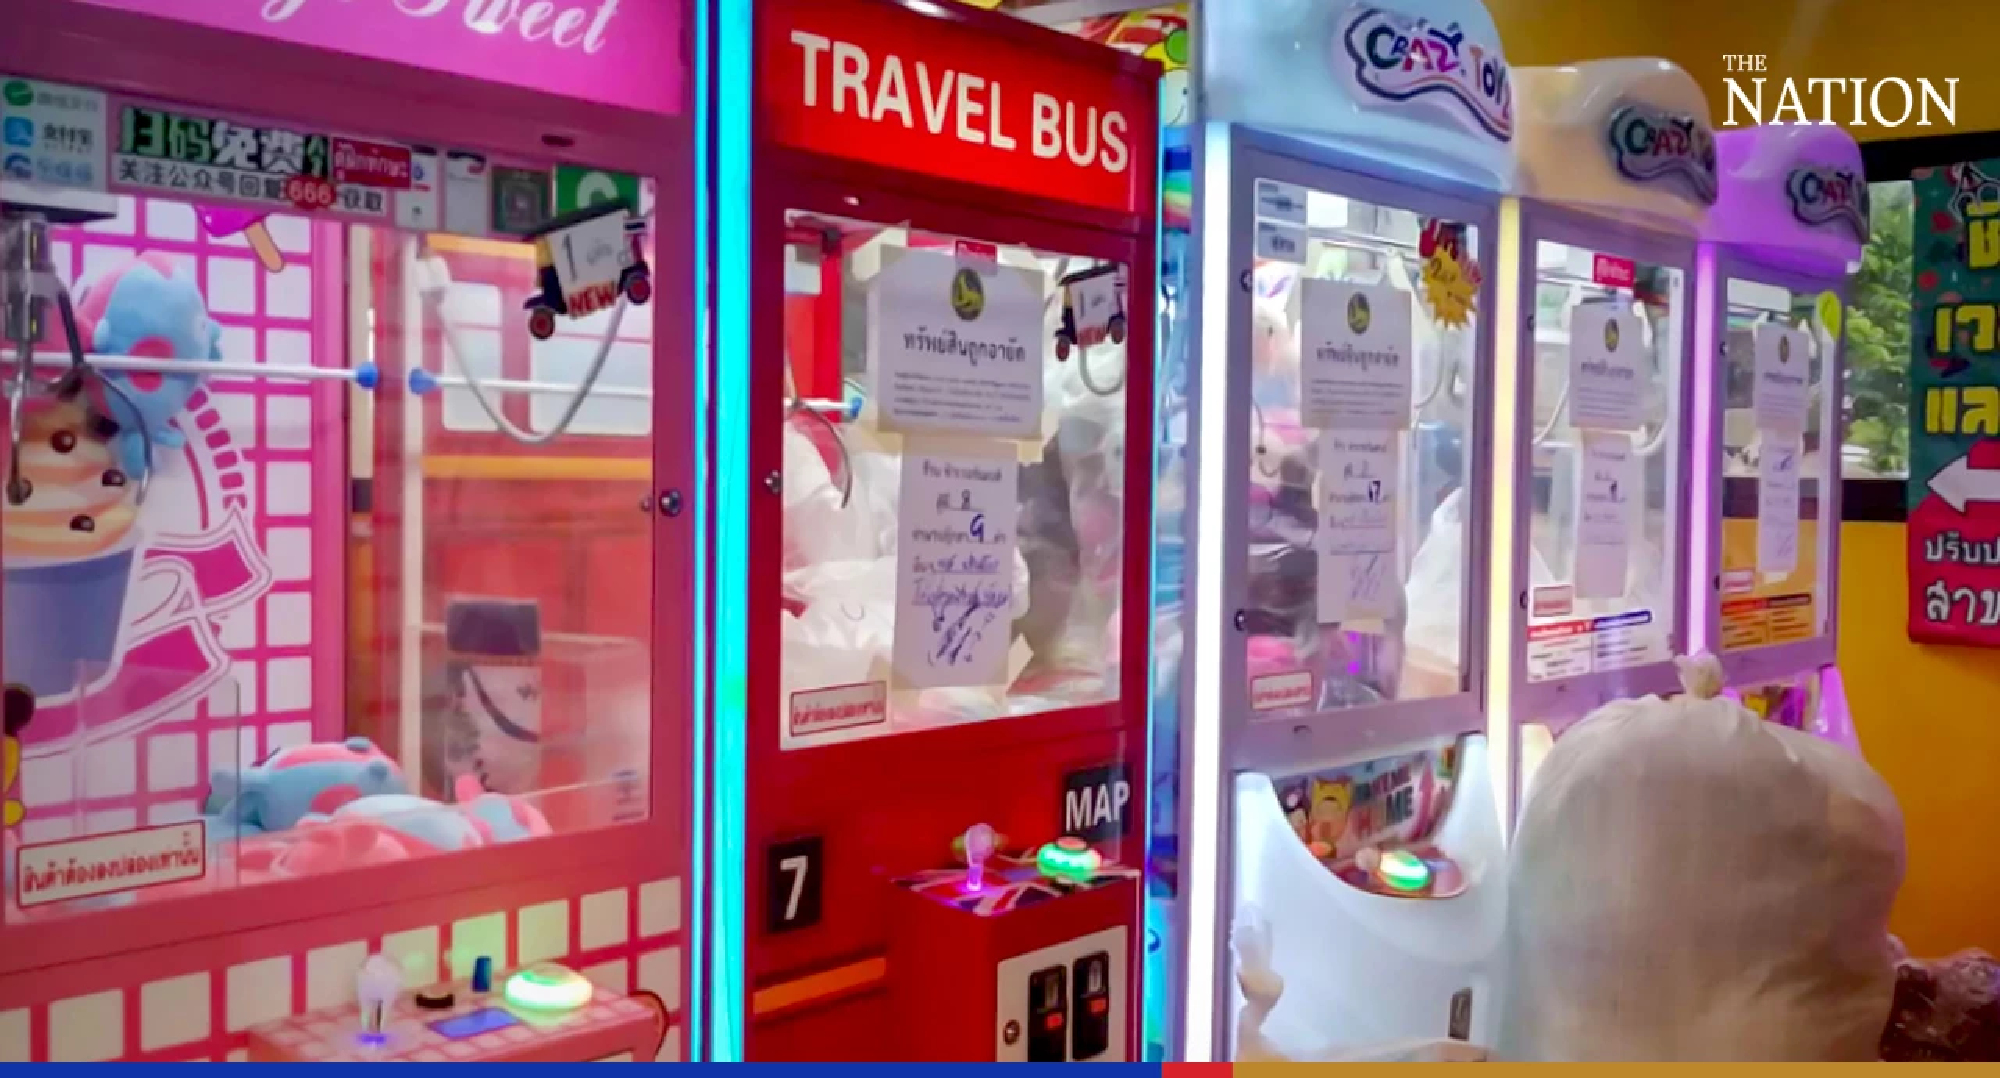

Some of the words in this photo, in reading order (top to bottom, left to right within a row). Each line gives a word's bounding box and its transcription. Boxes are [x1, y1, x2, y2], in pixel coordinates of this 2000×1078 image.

[791, 30, 1017, 151] TRAVEL
[1031, 92, 1129, 173] BUS
[568, 285, 618, 317] NEW
[1065, 779, 1131, 832] MAP
[779, 855, 808, 921] 7
